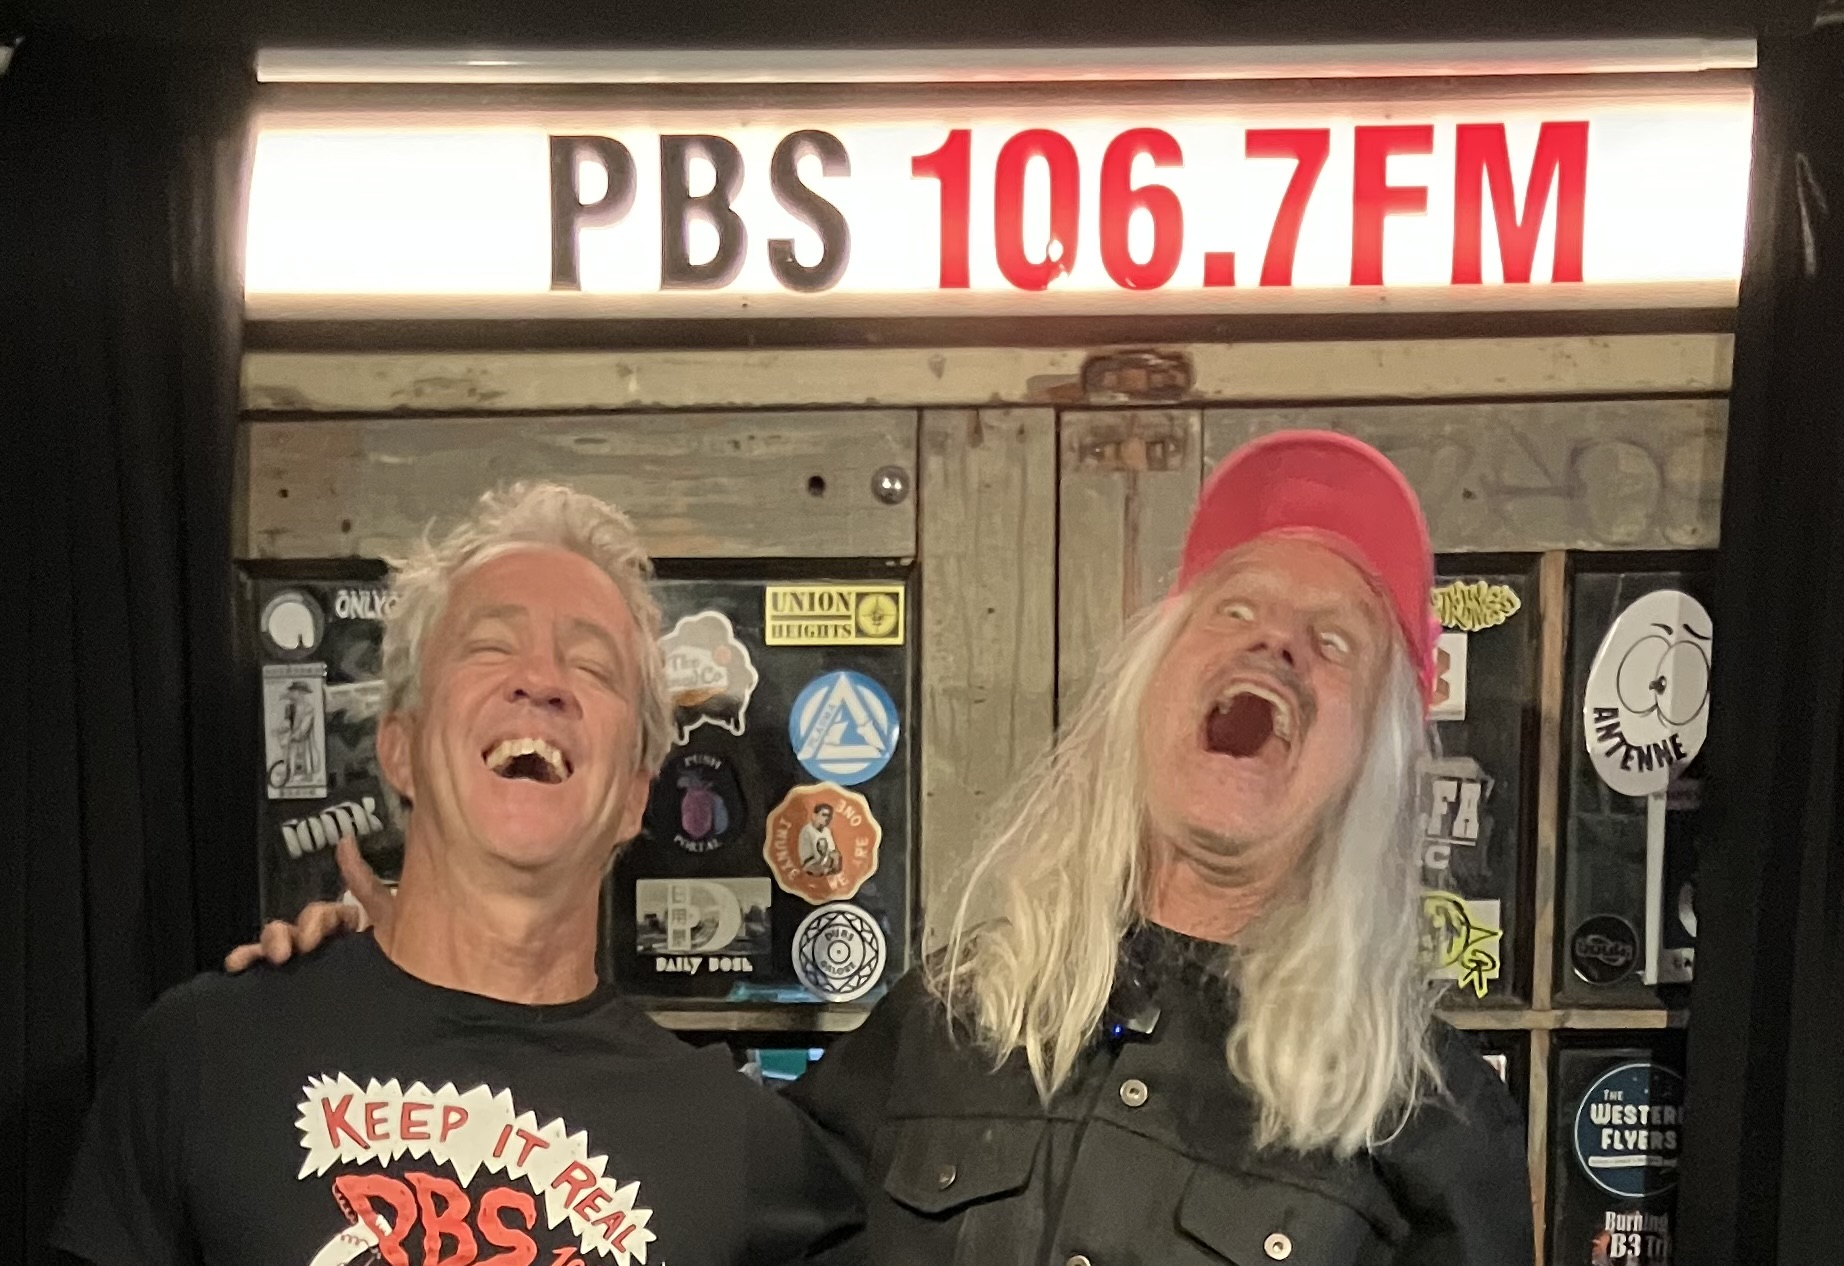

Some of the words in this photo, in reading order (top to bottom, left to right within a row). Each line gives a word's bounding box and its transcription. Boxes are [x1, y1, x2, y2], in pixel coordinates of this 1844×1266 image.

[548, 129, 852, 293] PBS
[911, 121, 1590, 291] 106.7FM
[772, 592, 850, 612] UNION
[771, 624, 852, 639] HEIGHTS
[1593, 707, 1687, 773] ANTENNE
[656, 956, 703, 975] DAILY
[1603, 1089, 1624, 1102] THE
[1600, 1128, 1678, 1151] FLYERS
[322, 1094, 469, 1151] KEEP
[492, 1123, 550, 1169] IT
[550, 1160, 640, 1254] REAL
[1610, 1233, 1642, 1259] B3
